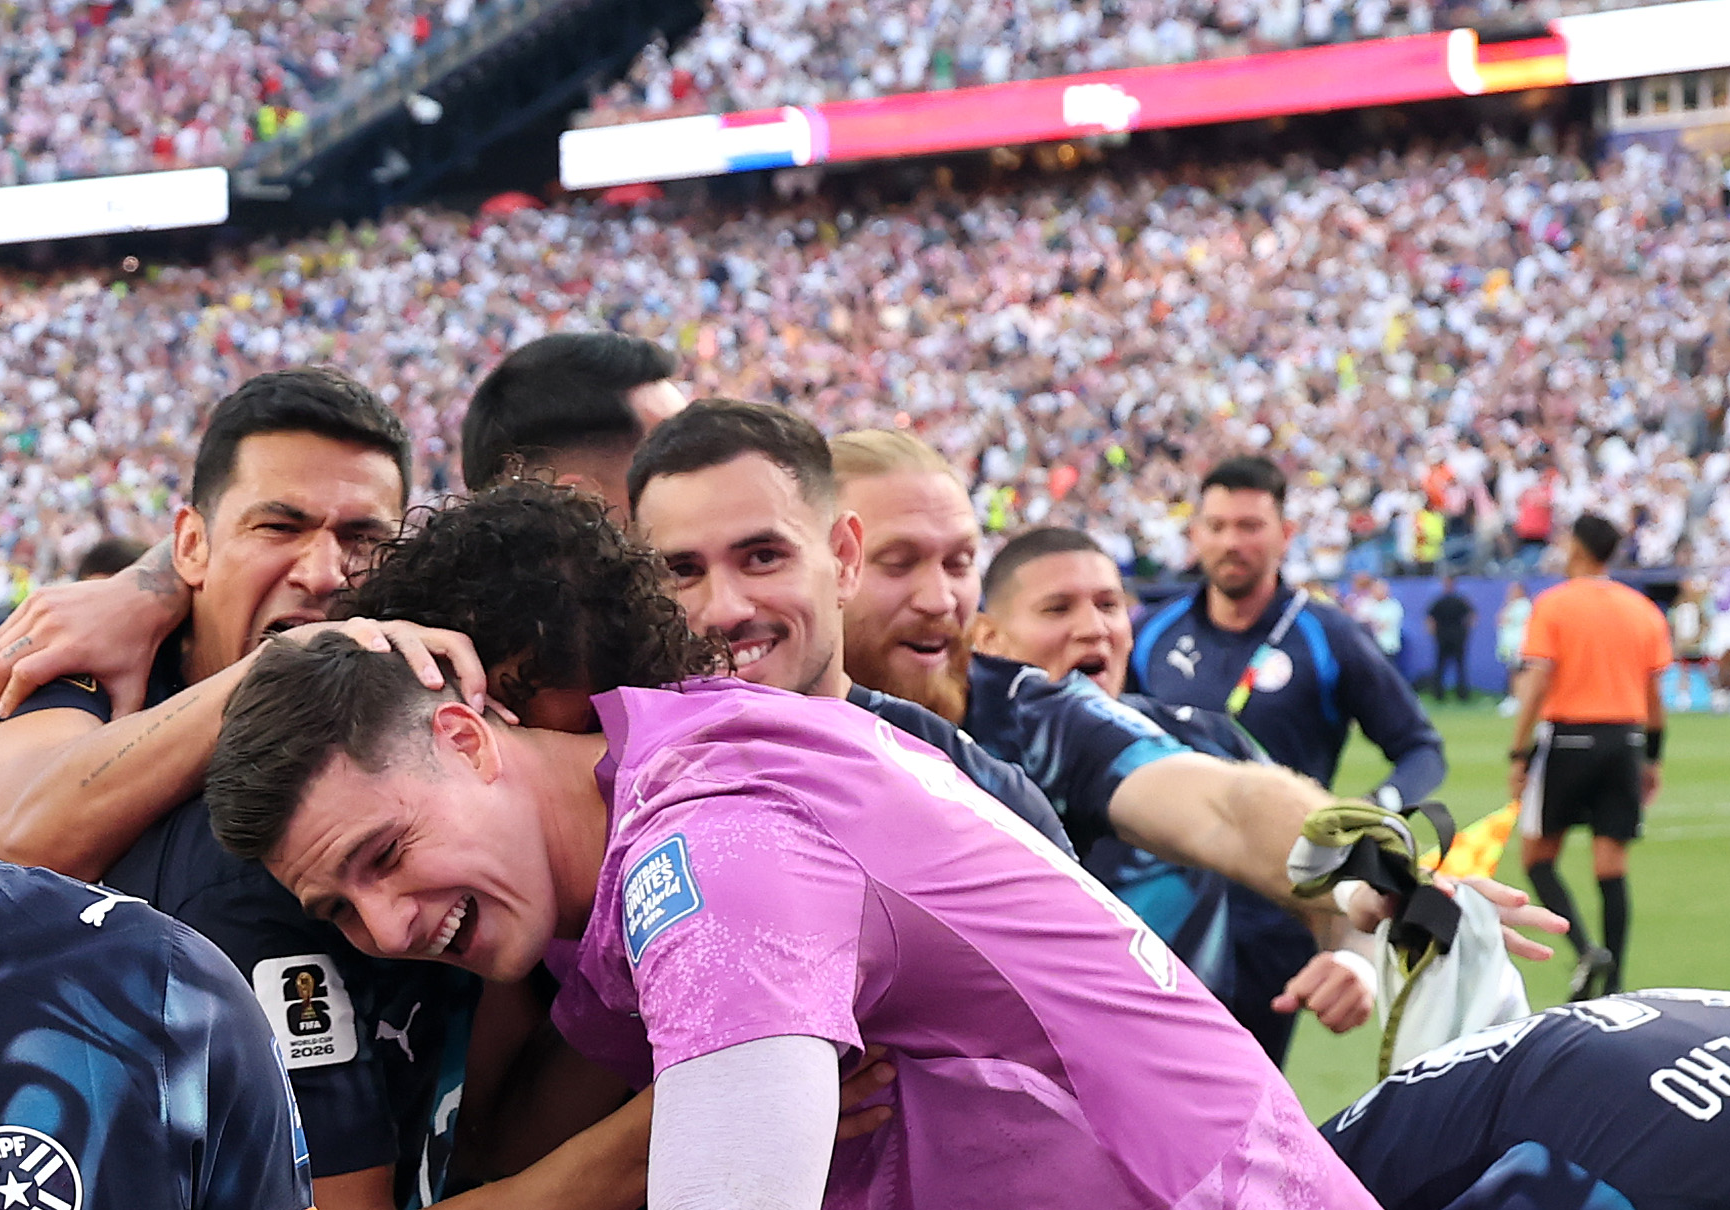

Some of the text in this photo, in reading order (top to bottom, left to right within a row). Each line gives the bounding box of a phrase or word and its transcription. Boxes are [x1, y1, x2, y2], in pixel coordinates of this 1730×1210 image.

[626, 862, 675, 918] UNITES
[641, 876, 682, 917] World
[642, 907, 667, 931] FIFA
[298, 1020, 322, 1031] FIFA
[290, 1044, 336, 1059] 2026
